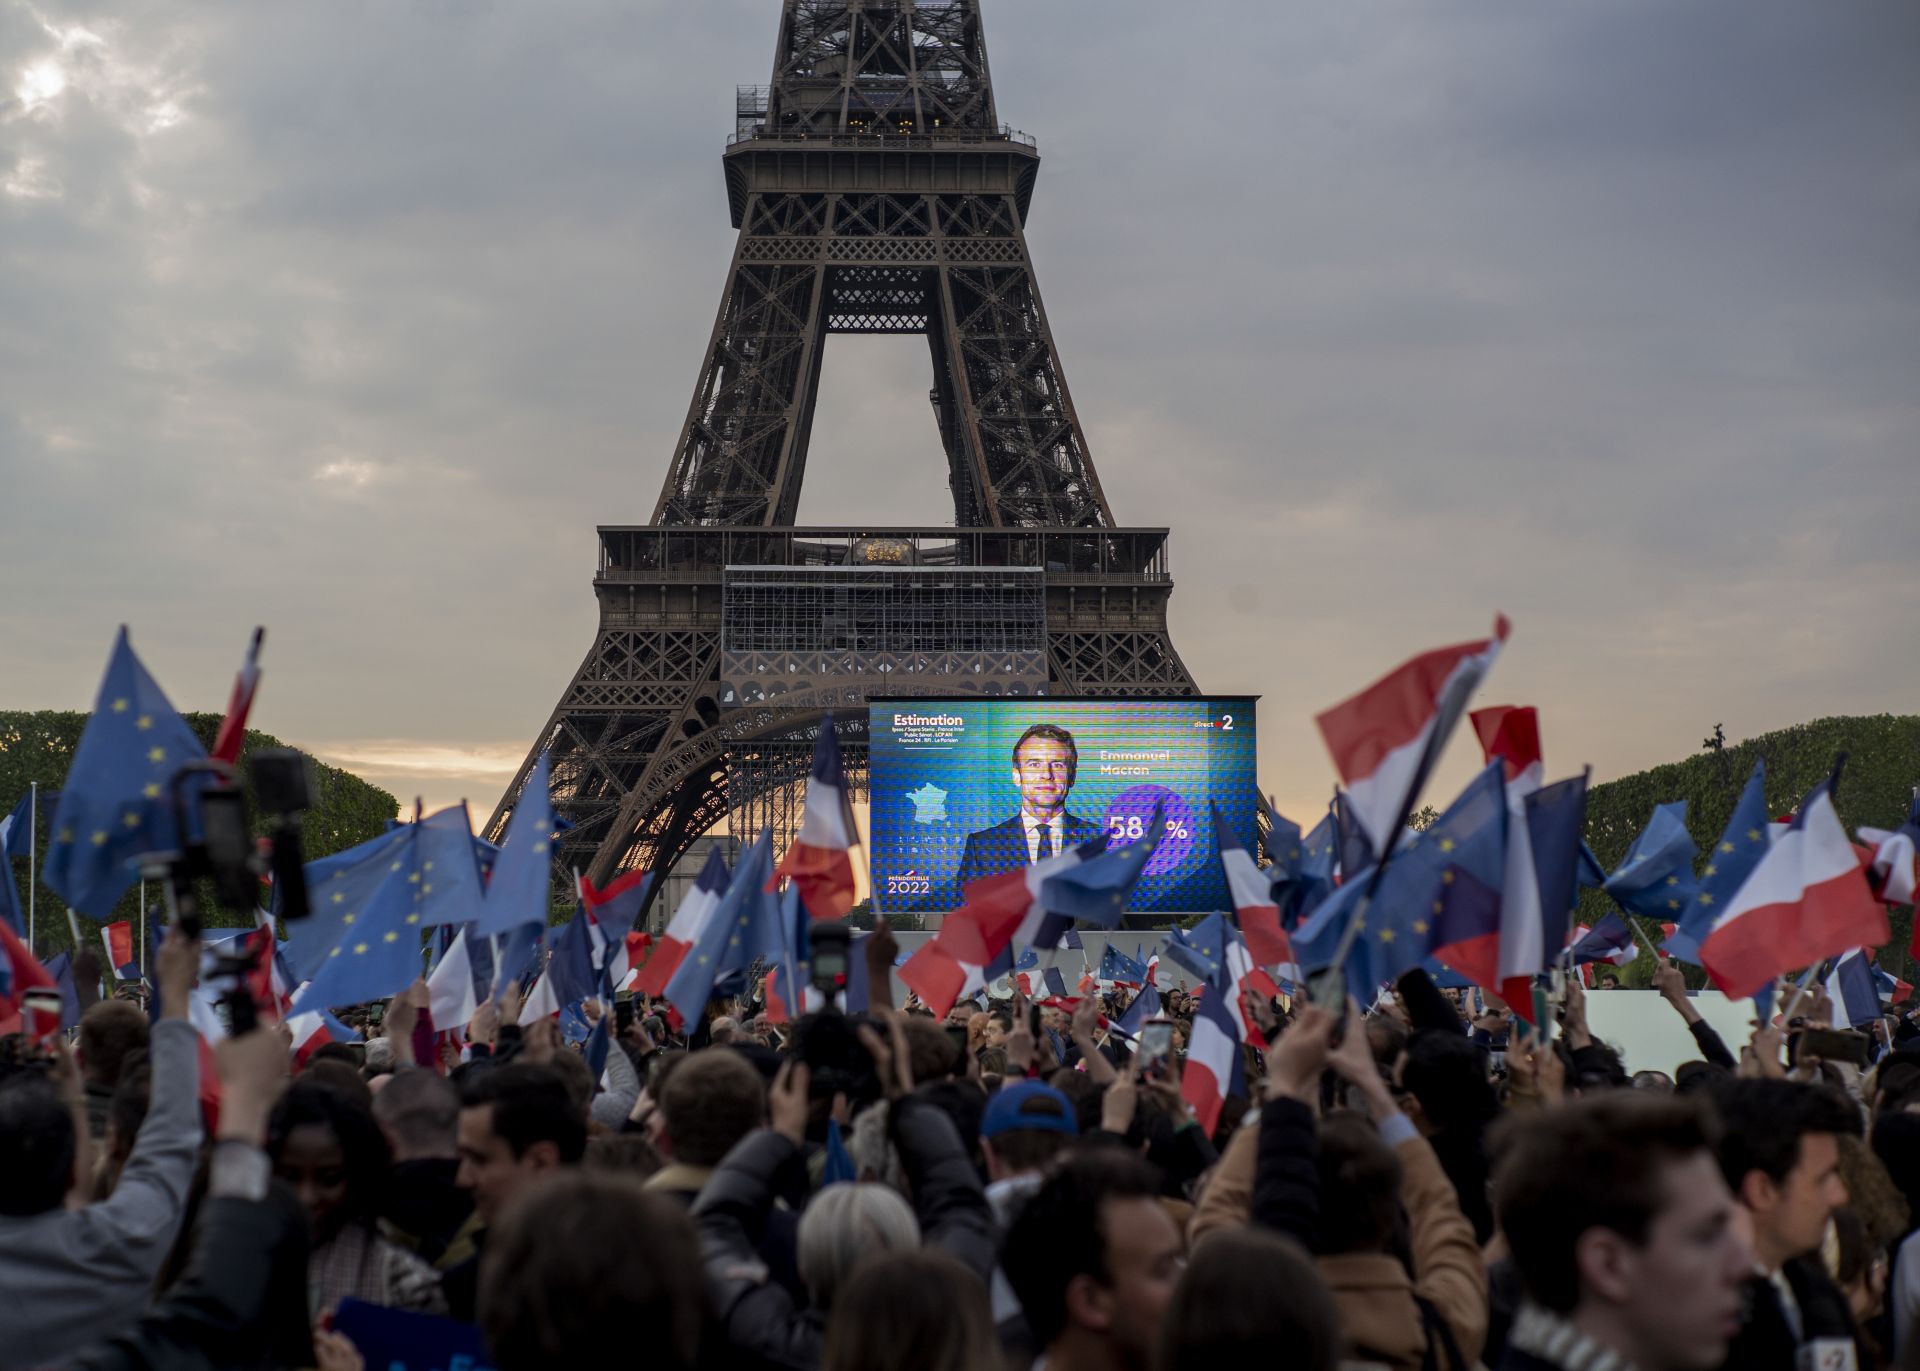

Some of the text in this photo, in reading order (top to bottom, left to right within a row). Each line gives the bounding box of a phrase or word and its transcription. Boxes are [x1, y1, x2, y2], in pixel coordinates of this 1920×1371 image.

[894, 714, 962, 726] Estimation
[1222, 715, 1233, 730] 2
[1100, 751, 1170, 761] Emmanuel
[1100, 765, 1149, 775] Macron
[1165, 820, 1188, 839] %
[888, 882, 929, 893] 2022
